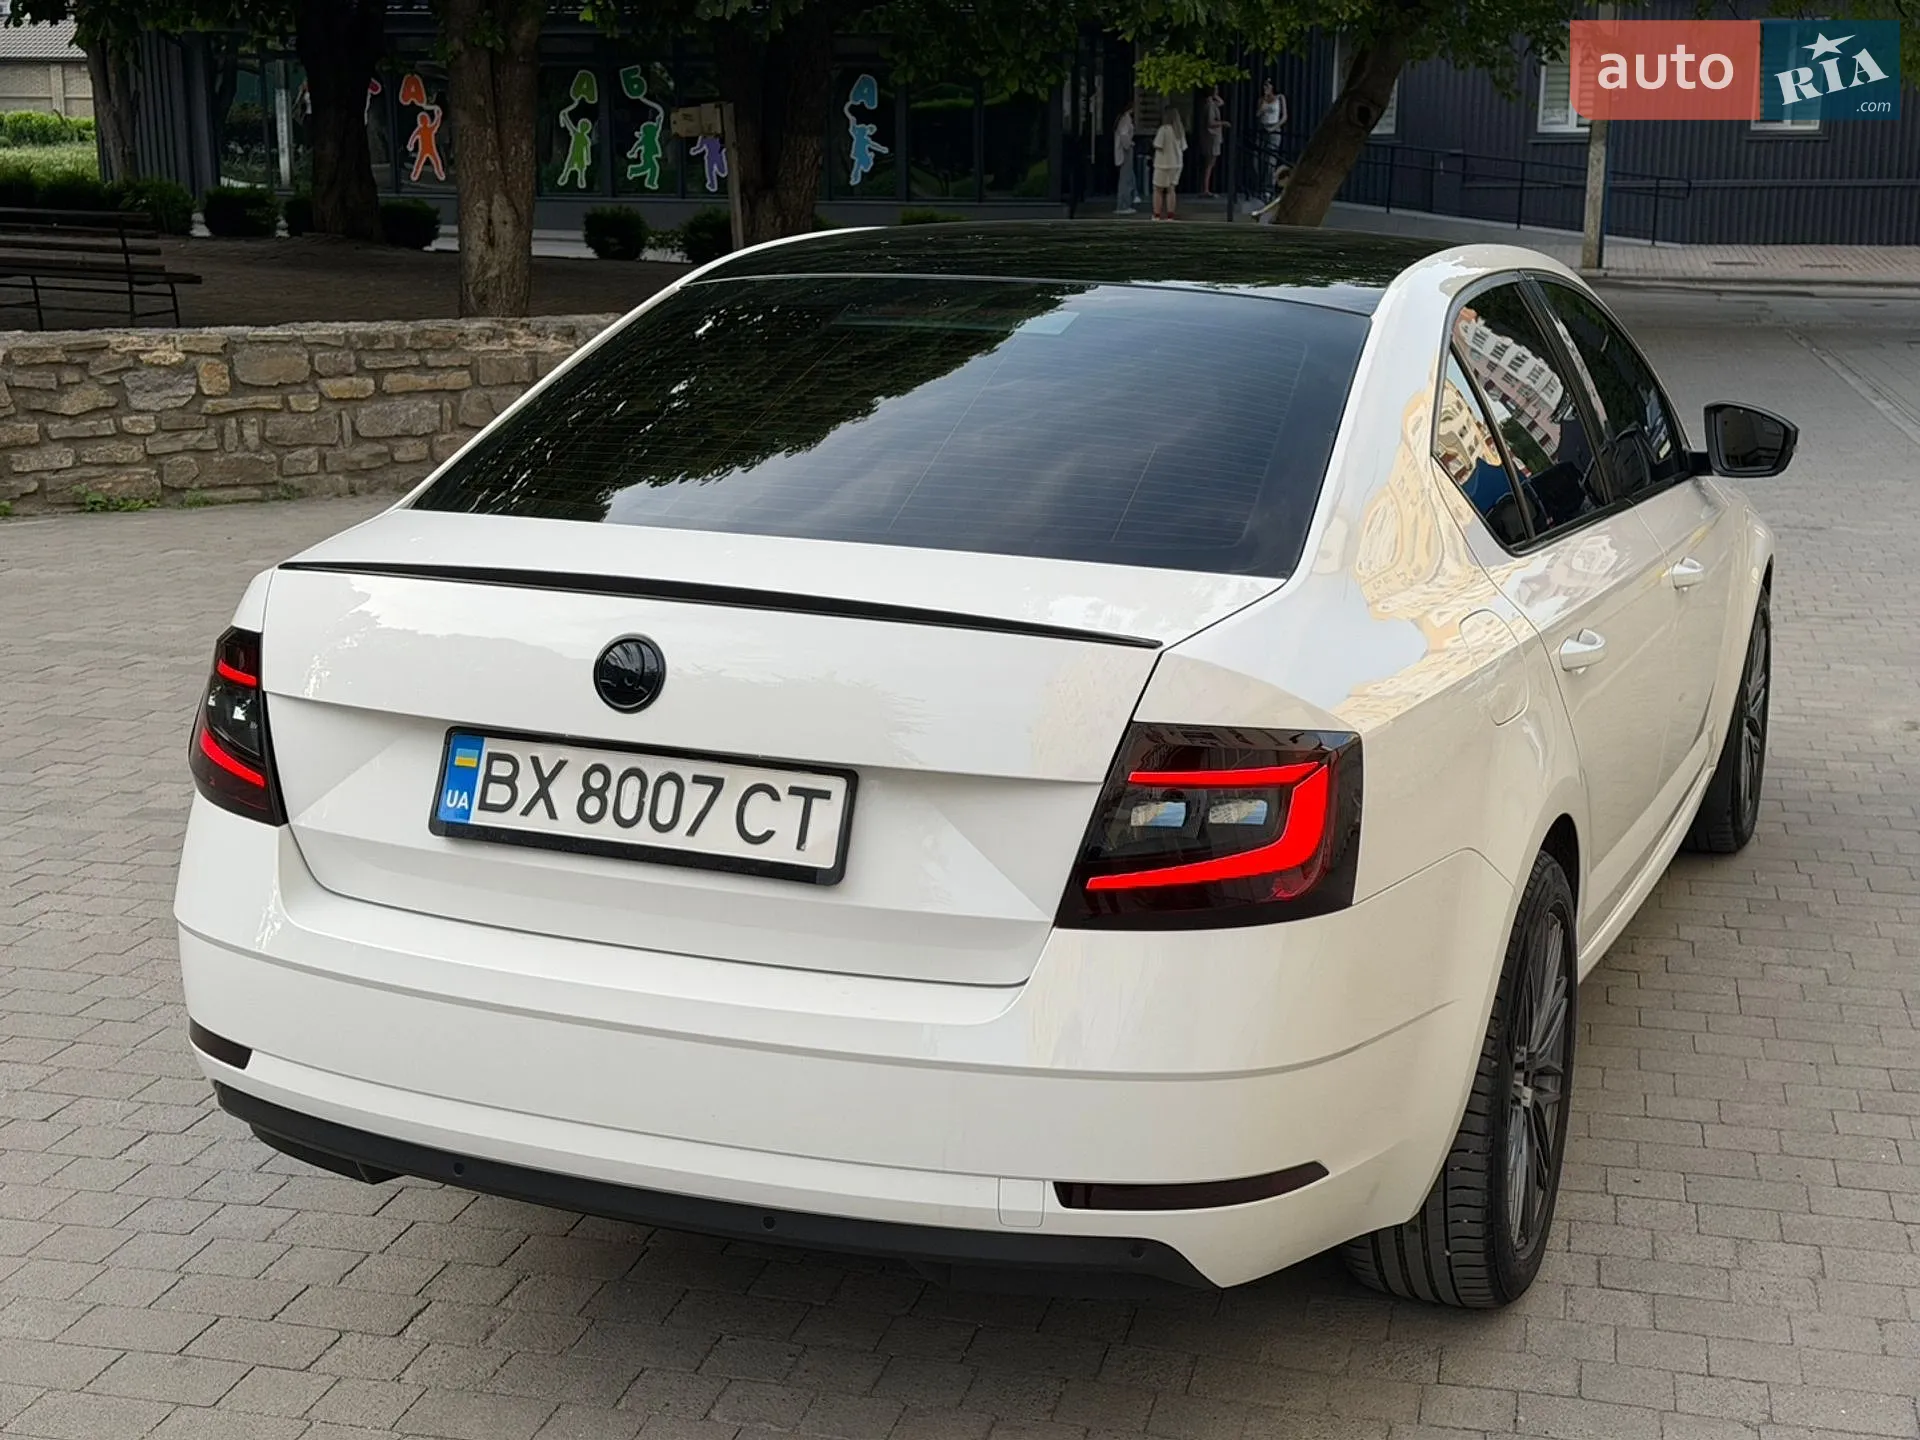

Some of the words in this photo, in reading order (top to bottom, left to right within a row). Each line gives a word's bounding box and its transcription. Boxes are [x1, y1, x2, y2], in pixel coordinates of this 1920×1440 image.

[446, 789, 470, 811] UA
[478, 751, 568, 820] BX
[575, 763, 725, 837] 8007
[735, 782, 832, 851] CT
